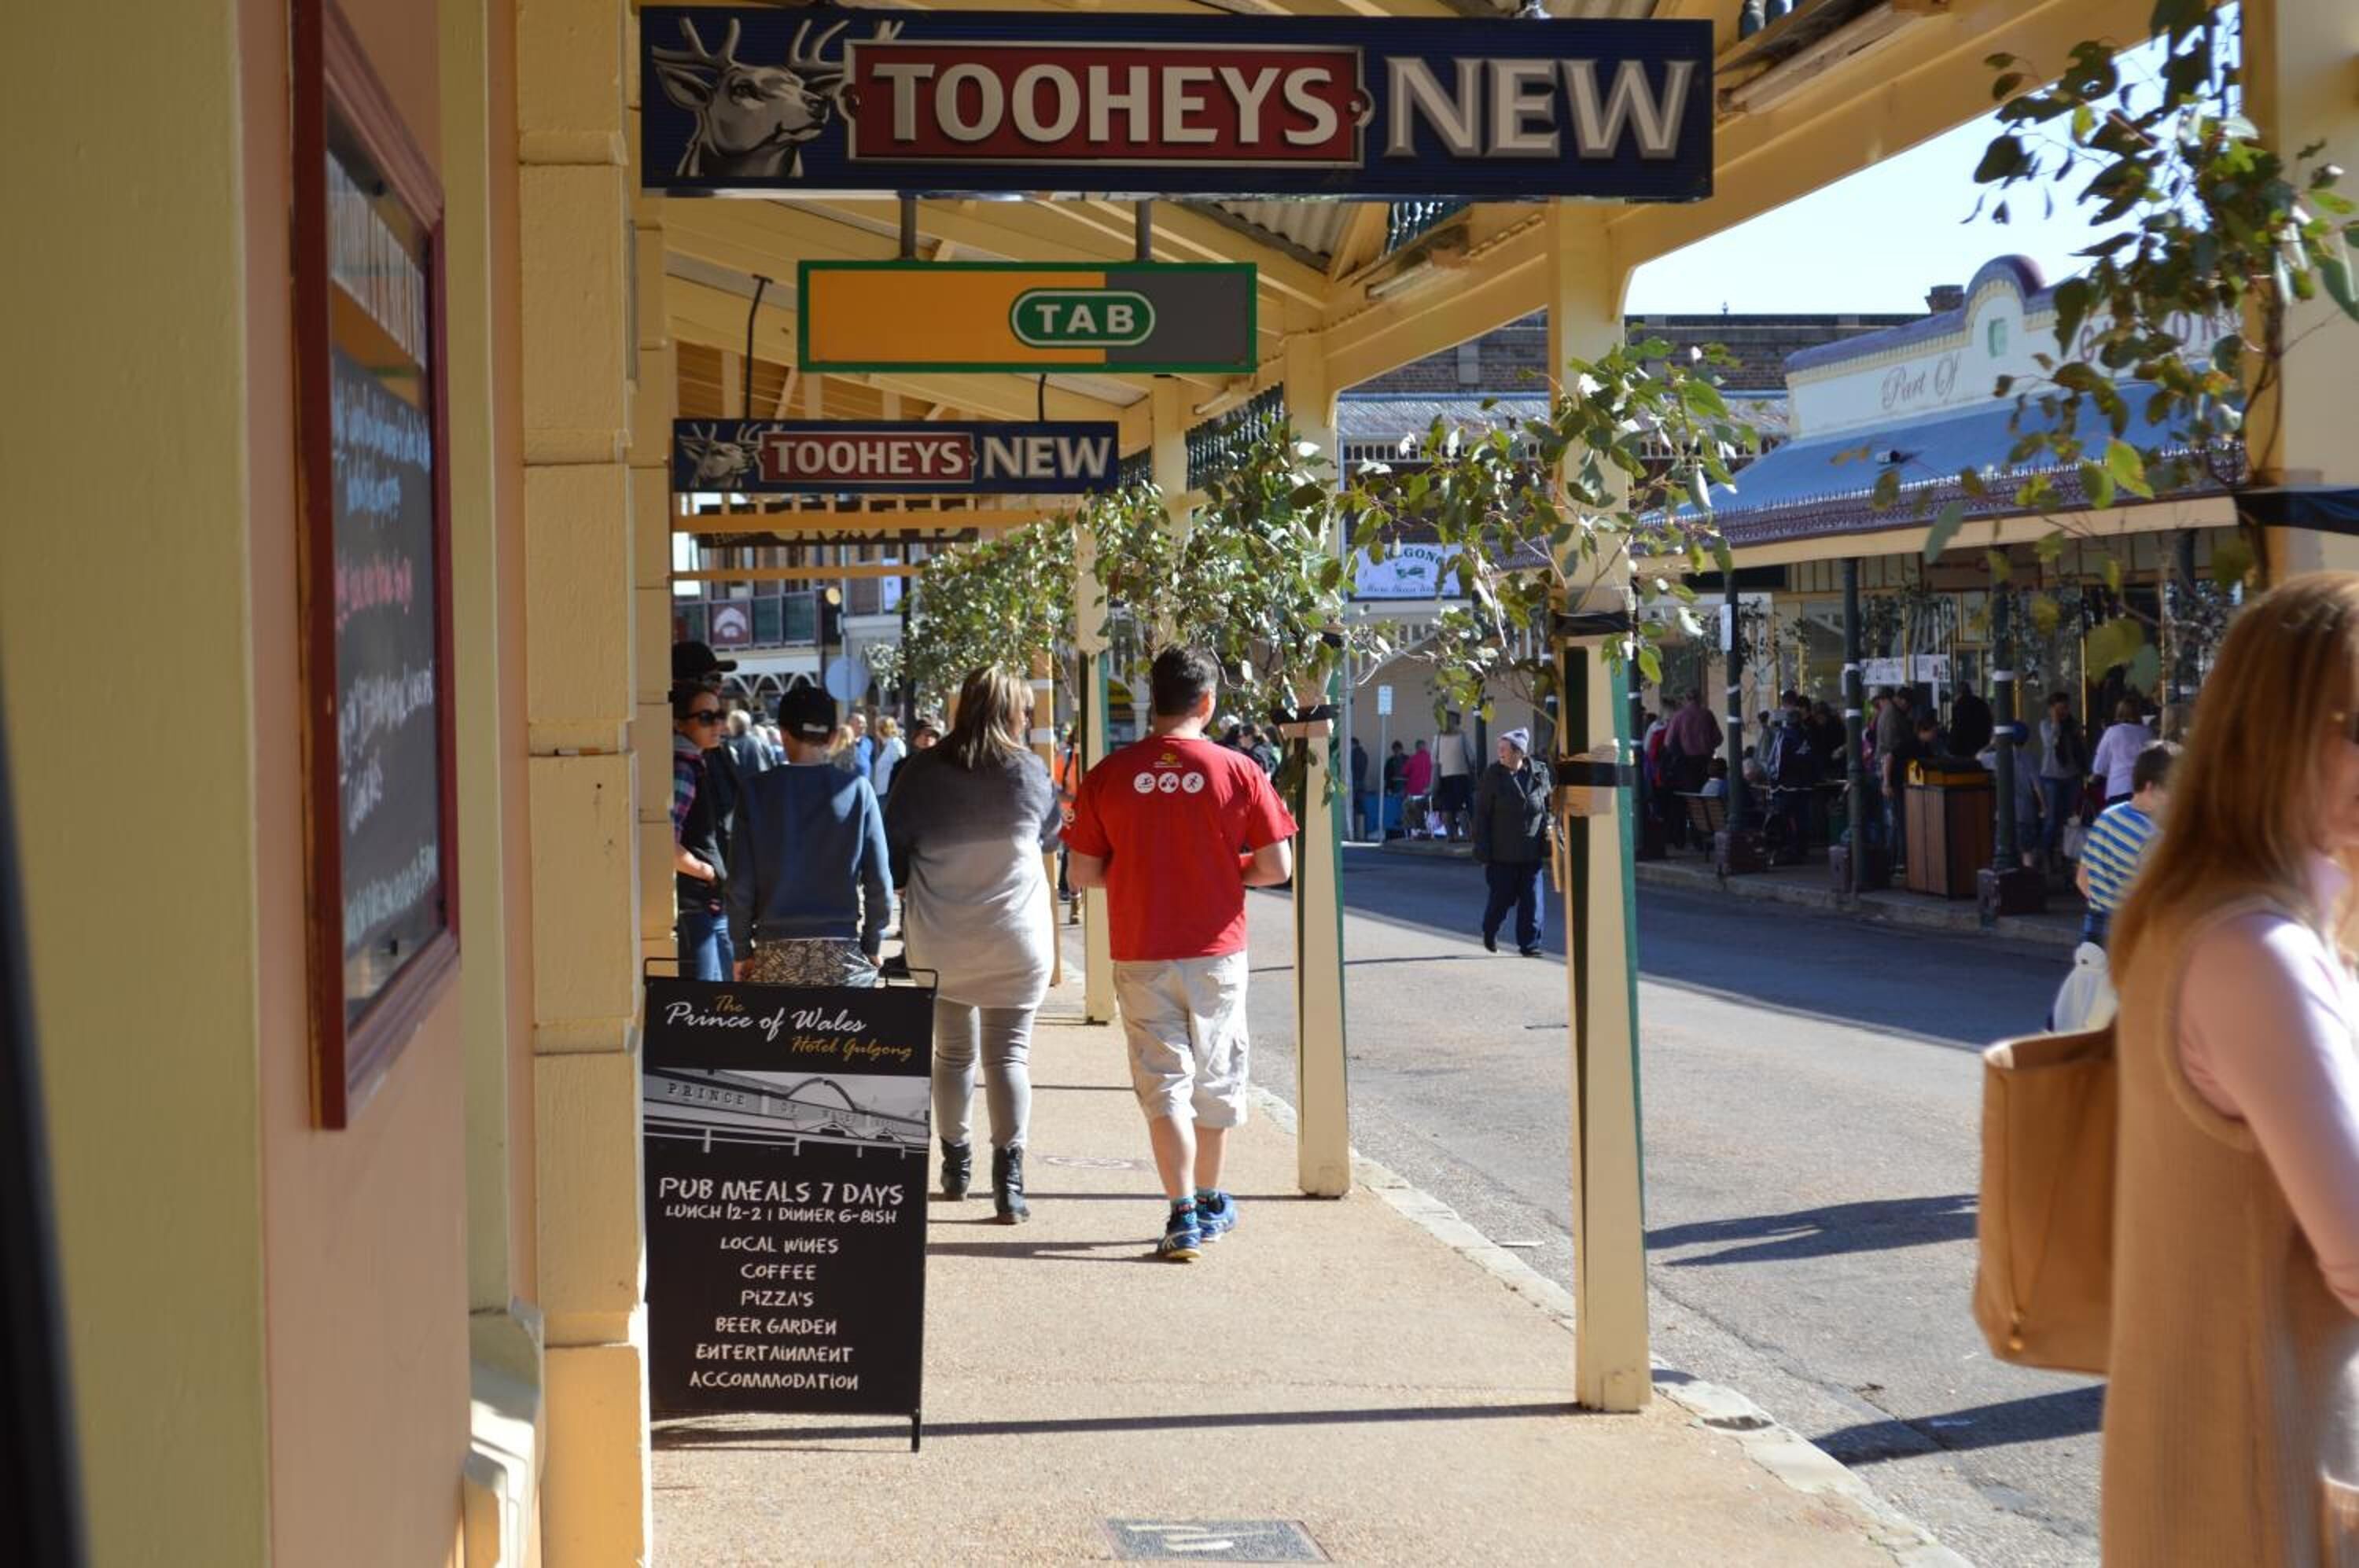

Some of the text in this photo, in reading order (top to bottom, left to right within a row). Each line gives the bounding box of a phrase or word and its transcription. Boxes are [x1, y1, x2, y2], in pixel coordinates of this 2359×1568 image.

[872, 56, 1697, 158] TOOHEYS NEW
[1035, 304, 1135, 334] TAB
[1881, 364, 1926, 410] Part
[770, 436, 1113, 480] TOOHEYS NEW
[715, 994, 745, 1013] The
[664, 1000, 867, 1043] Prince of Wales
[791, 1035, 914, 1062] Hotel Gulgong
[668, 1082, 745, 1106] PRINCE
[659, 1177, 903, 1208] PUB MEALS 7 DAYS
[665, 1204, 722, 1219] LUNCH
[727, 1202, 762, 1221] 12-2
[720, 1236, 776, 1253] LOCAL
[740, 1263, 816, 1280] COFFEE
[716, 1316, 837, 1335] BEER GARDEN
